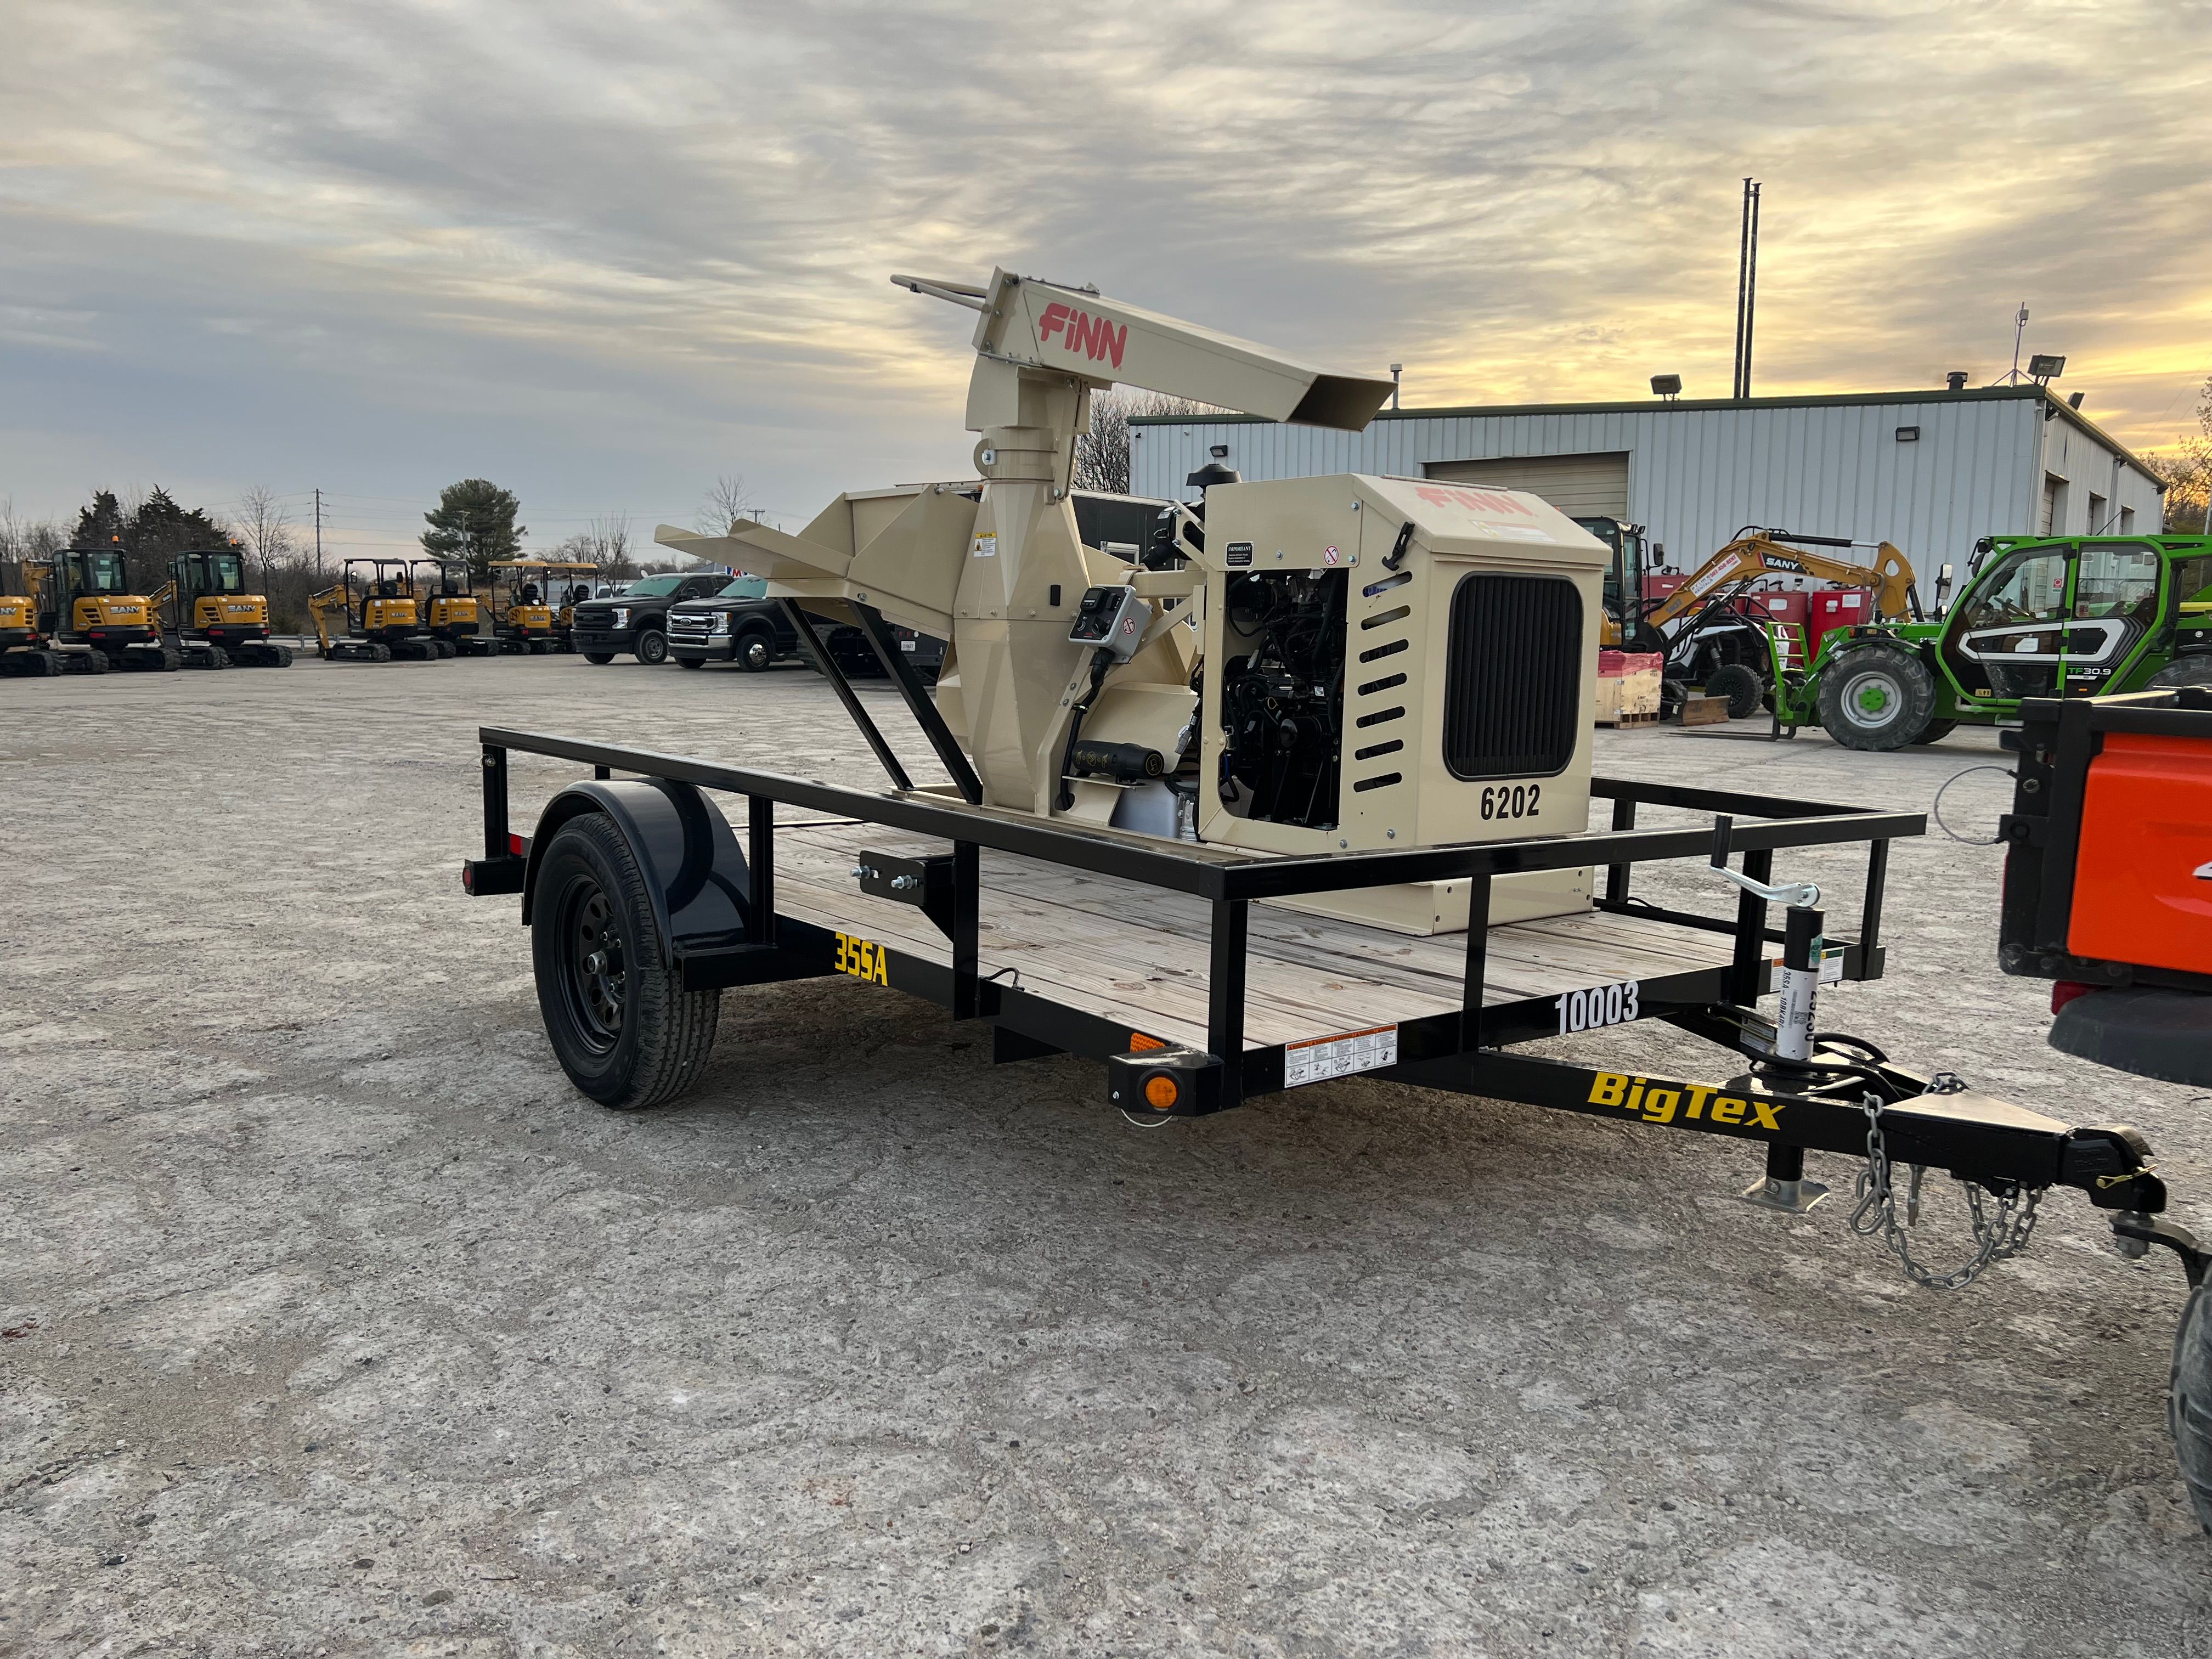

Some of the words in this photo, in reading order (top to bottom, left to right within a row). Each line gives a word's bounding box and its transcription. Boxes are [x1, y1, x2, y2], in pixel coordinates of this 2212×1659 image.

[1766, 557, 1799, 570] SANY
[2068, 667, 2112, 675] TF30.9
[1481, 784, 1540, 820] 6202
[835, 932, 888, 986] 35SA
[1782, 970, 1791, 989] 35SA
[1555, 980, 1639, 1036] 10003
[1587, 1071, 1786, 1130] BigTex
